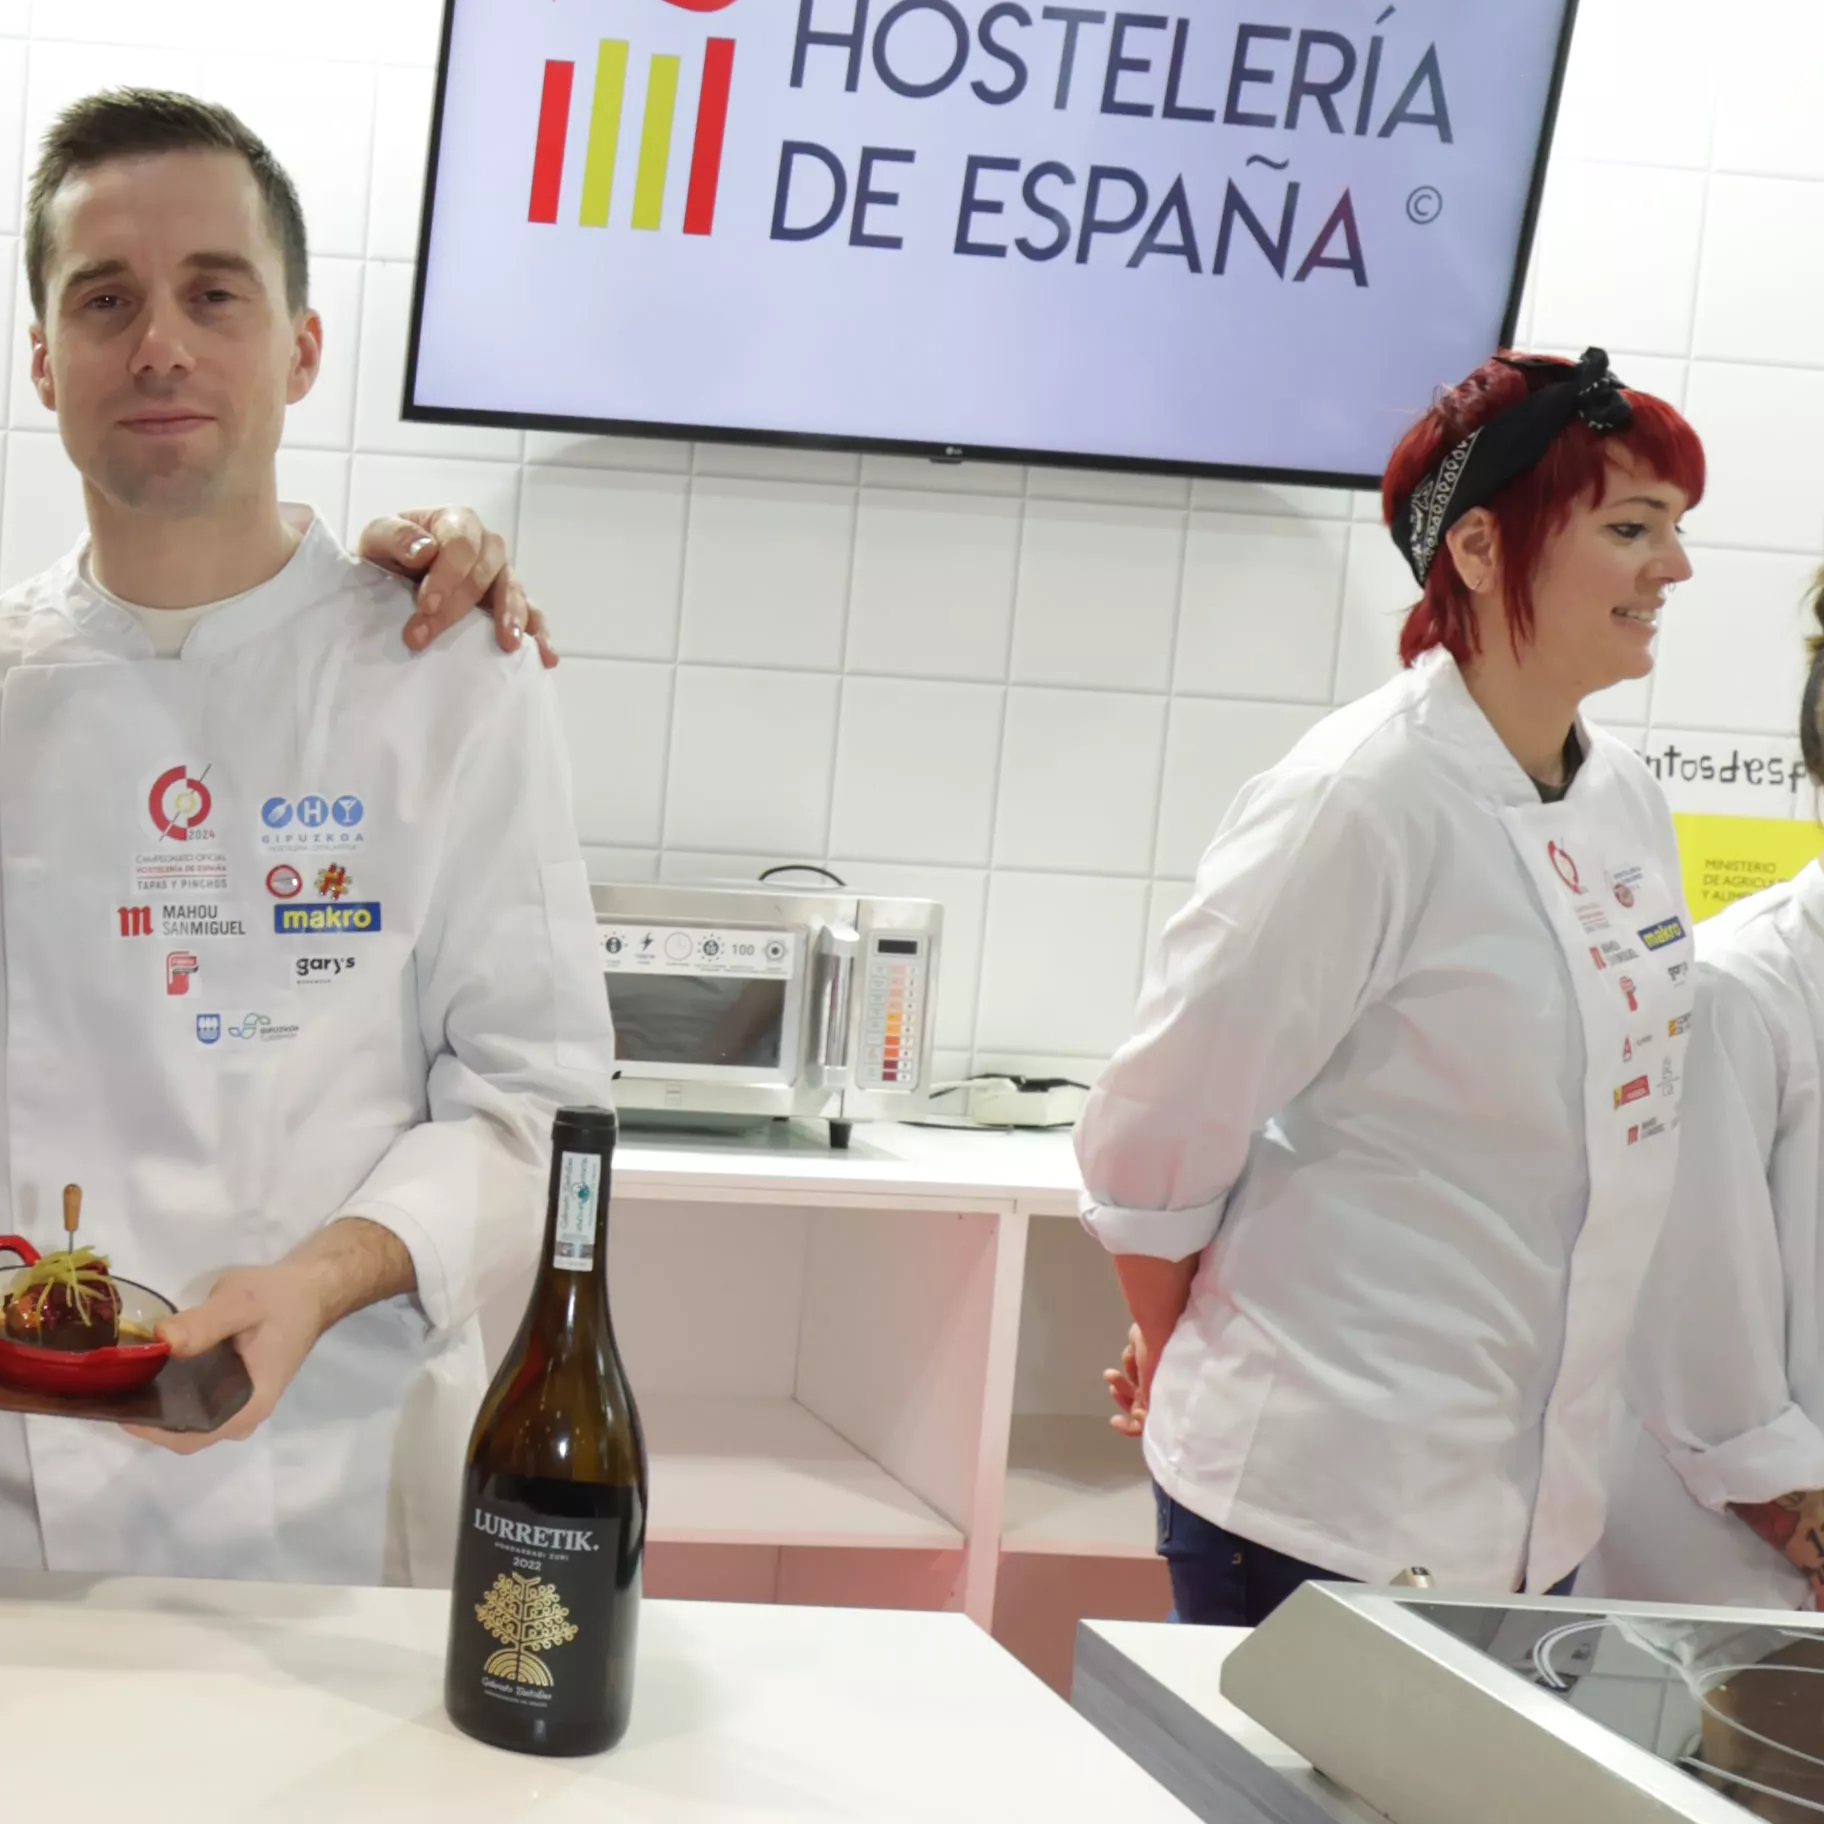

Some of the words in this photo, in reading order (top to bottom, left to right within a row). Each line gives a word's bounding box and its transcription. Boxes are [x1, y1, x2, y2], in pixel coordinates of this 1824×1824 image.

[769, 139, 916, 251] DE
[953, 154, 1370, 287] ESPAÑA
[1704, 859, 1776, 874] MINISTERIO
[137, 880, 167, 890] TAPAS
[171, 880, 177, 888] Y
[181, 879, 227, 888] PINCHOS
[1704, 875, 1720, 886] DE
[163, 905, 218, 919] MAHOU
[283, 907, 372, 930] makro
[162, 921, 246, 936] SANMIGUEL
[732, 944, 755, 956] 100
[513, 1556, 542, 1571] 2022
